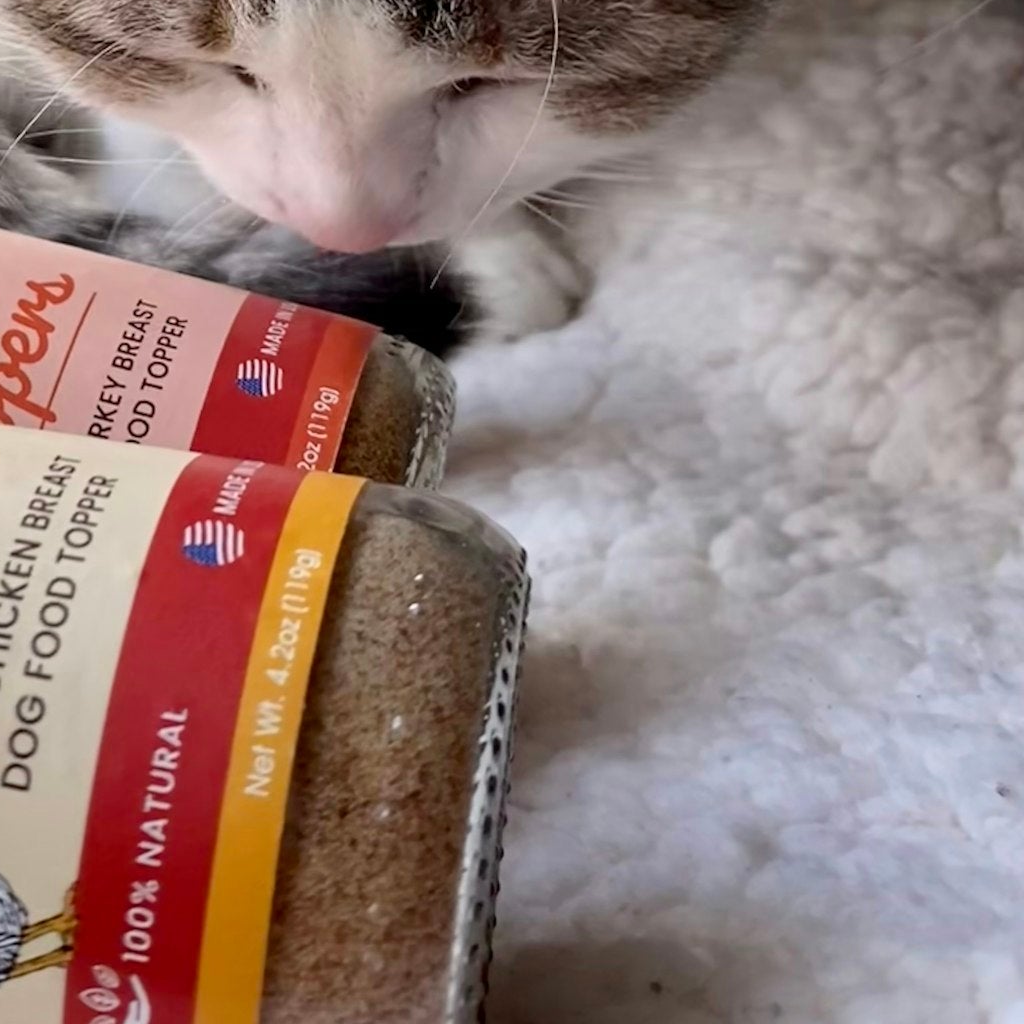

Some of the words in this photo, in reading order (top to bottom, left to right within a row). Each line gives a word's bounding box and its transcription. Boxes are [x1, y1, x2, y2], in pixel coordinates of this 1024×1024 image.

[87, 374, 127, 439] RKEY
[111, 298, 158, 371] BREAST
[140, 315, 189, 390] TOPPER
[259, 319, 290, 356] MADE
[125, 400, 156, 444] OD
[306, 386, 340, 440] (119g)
[20, 453, 82, 532] BREAST
[211, 473, 251, 516] MADE
[296, 441, 322, 471] 2oz
[56, 474, 119, 567] TOPPER
[22, 576, 77, 682] FOOD
[0, 693, 47, 792] DOG
[242, 744, 276, 797] Net
[265, 617, 302, 686] 4.2oz
[135, 707, 189, 868] NATURAL
[120, 878, 161, 964] 100%
